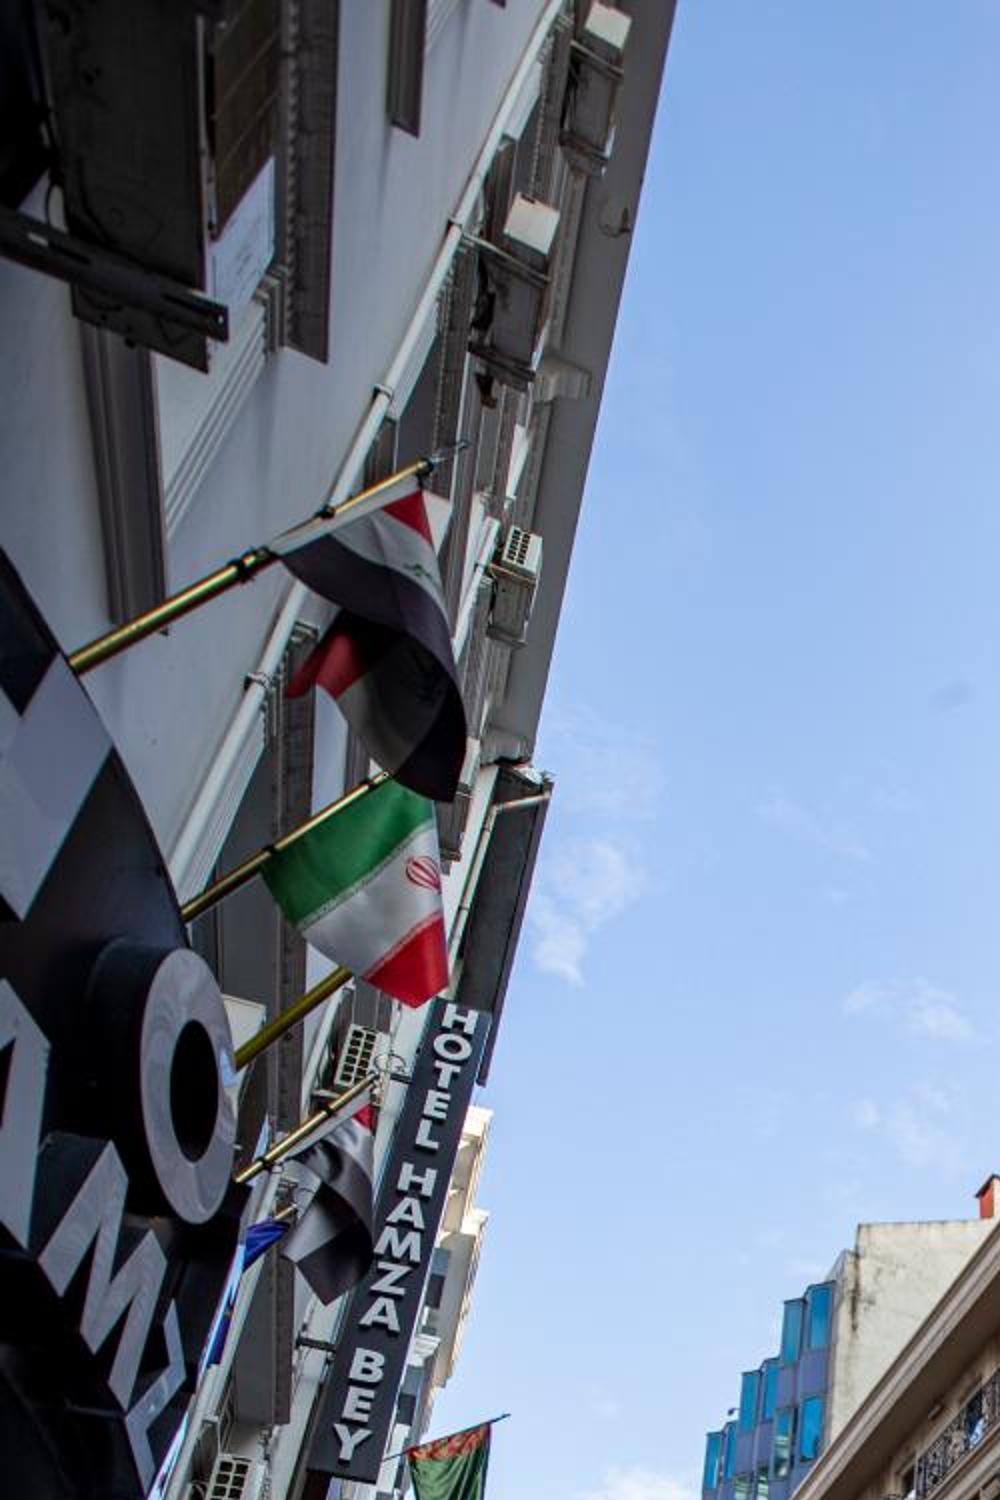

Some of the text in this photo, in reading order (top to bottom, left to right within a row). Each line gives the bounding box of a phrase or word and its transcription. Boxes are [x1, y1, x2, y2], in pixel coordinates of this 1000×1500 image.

[333, 1003, 478, 1467] HOTEL HAMZA BEY
